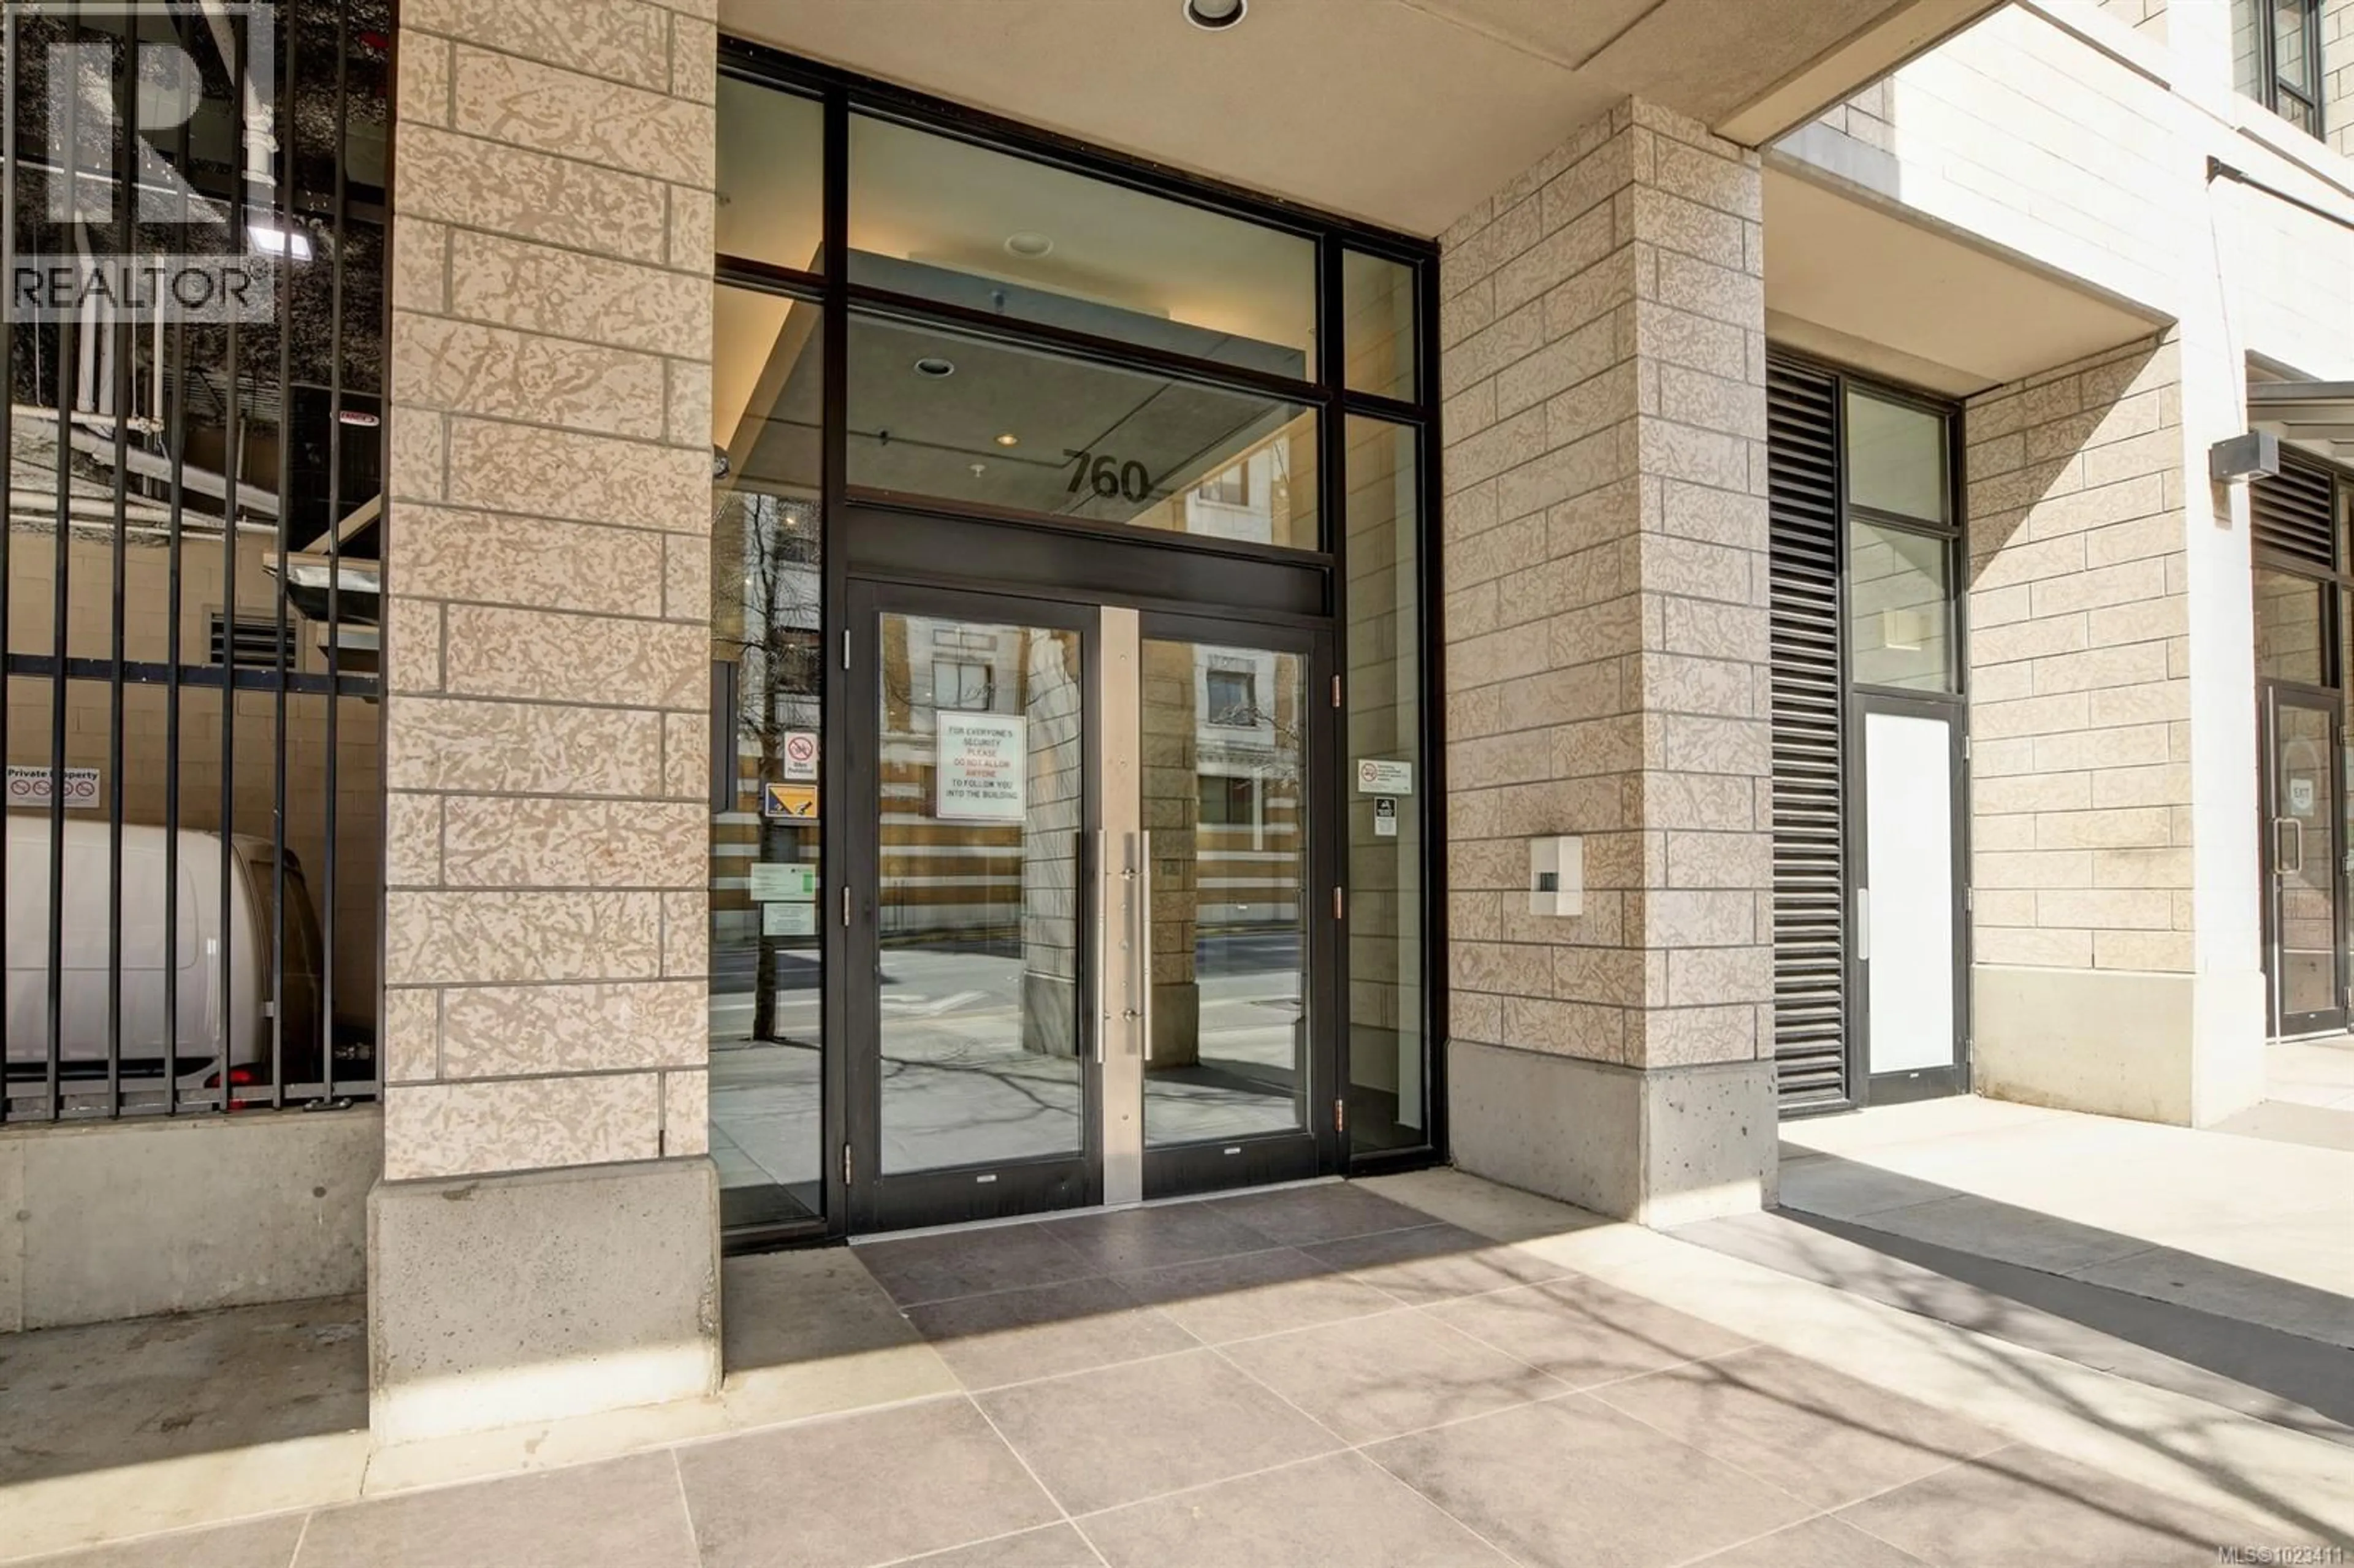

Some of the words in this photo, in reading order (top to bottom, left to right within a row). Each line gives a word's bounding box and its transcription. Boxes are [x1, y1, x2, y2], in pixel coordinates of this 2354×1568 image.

[1063, 449, 1149, 503] 760
[948, 726, 964, 735] FOR
[966, 728, 1013, 738] EVERYONE'S
[964, 737, 1001, 747] SECURITY
[967, 748, 996, 757] PLEASE
[8, 769, 48, 777] Private
[966, 769, 996, 777] ANYONE
[964, 780, 994, 788] FOLLOW
[997, 781, 1013, 790] YOU
[983, 791, 1018, 800] BUILDING
